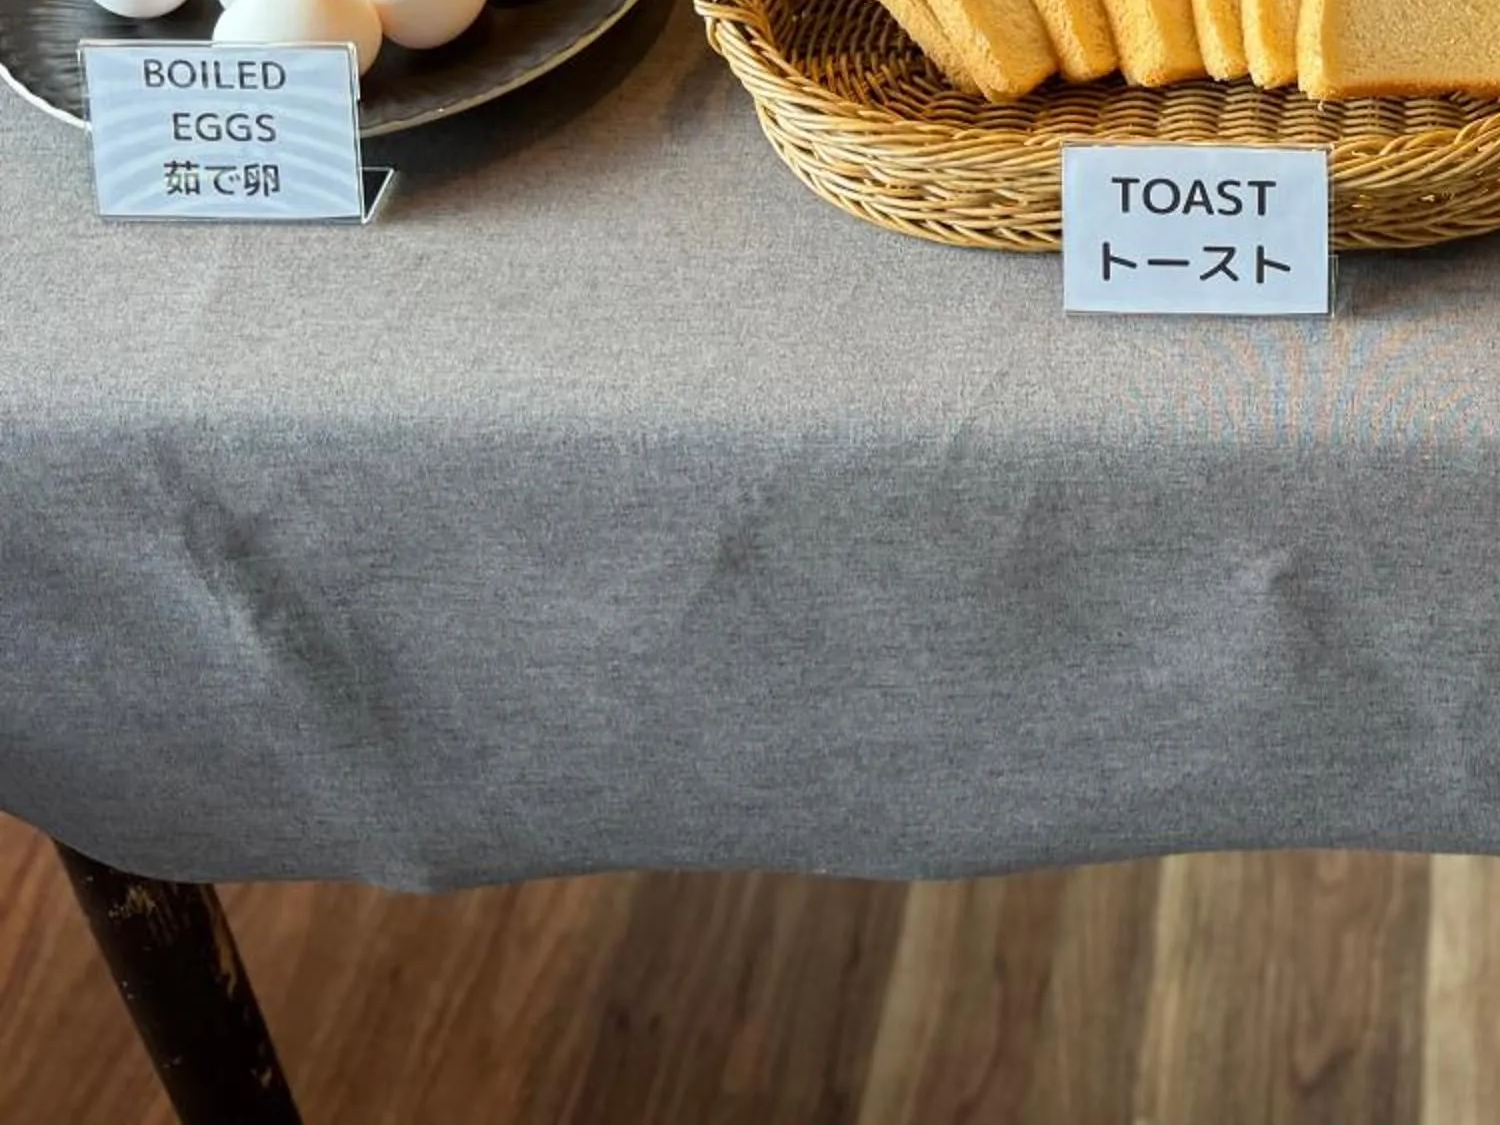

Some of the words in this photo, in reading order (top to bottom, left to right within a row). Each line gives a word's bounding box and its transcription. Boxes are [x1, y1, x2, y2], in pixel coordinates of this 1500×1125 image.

[143, 59, 286, 90] BOILED
[172, 112, 277, 142] EGGS
[164, 160, 280, 197] 茹で卵
[1112, 177, 1276, 216] TOAST
[1102, 242, 1291, 284] トースト
